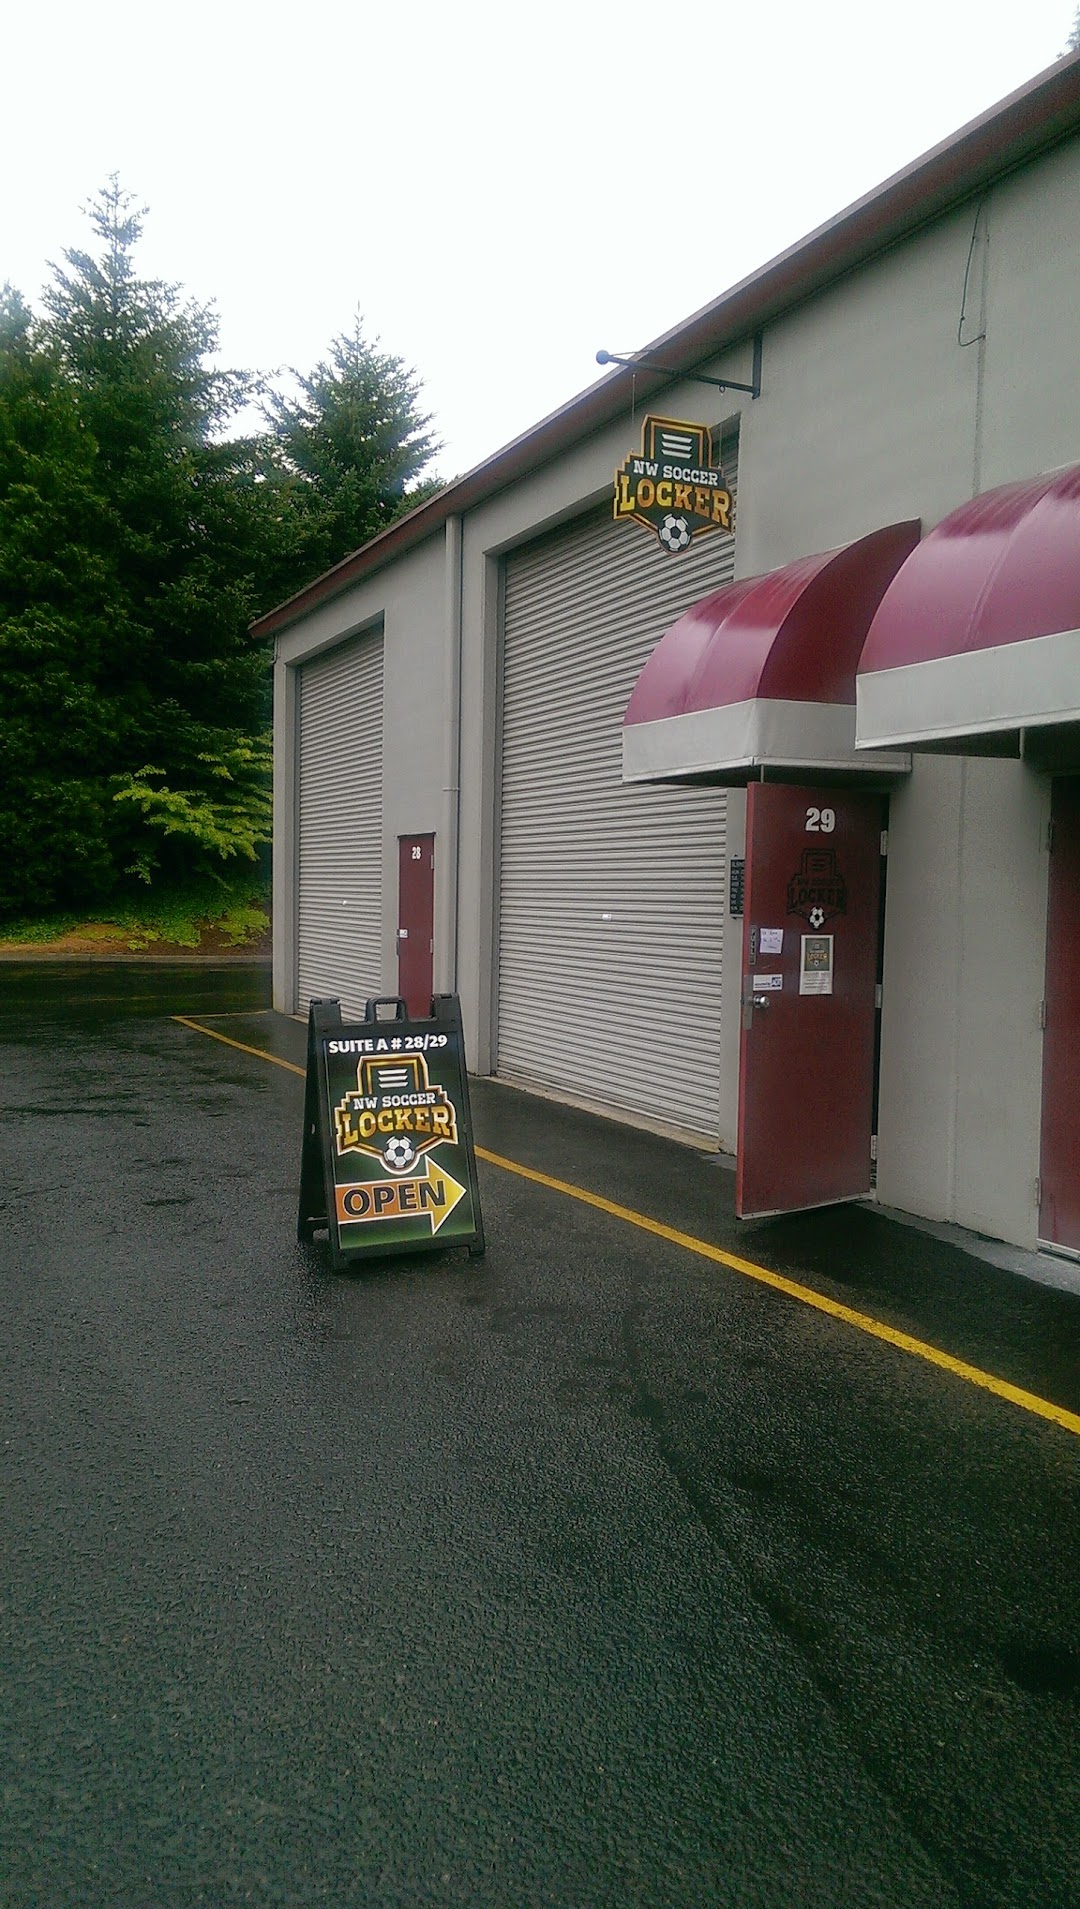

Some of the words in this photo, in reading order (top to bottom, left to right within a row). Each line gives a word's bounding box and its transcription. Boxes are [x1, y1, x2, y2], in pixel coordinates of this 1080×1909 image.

[633, 460, 659, 477] NW
[662, 465, 719, 486] SOCCER
[619, 474, 730, 527] LOCKER
[805, 807, 836, 833] 29
[411, 846, 422, 860] 28
[328, 1038, 374, 1054] SUITE
[376, 1038, 389, 1051] A
[404, 1034, 448, 1051] 28/29
[353, 1097, 378, 1110] NW
[381, 1092, 437, 1107] SOCCER
[342, 1106, 451, 1146] LOCKER
[343, 1180, 447, 1216] OPEN
